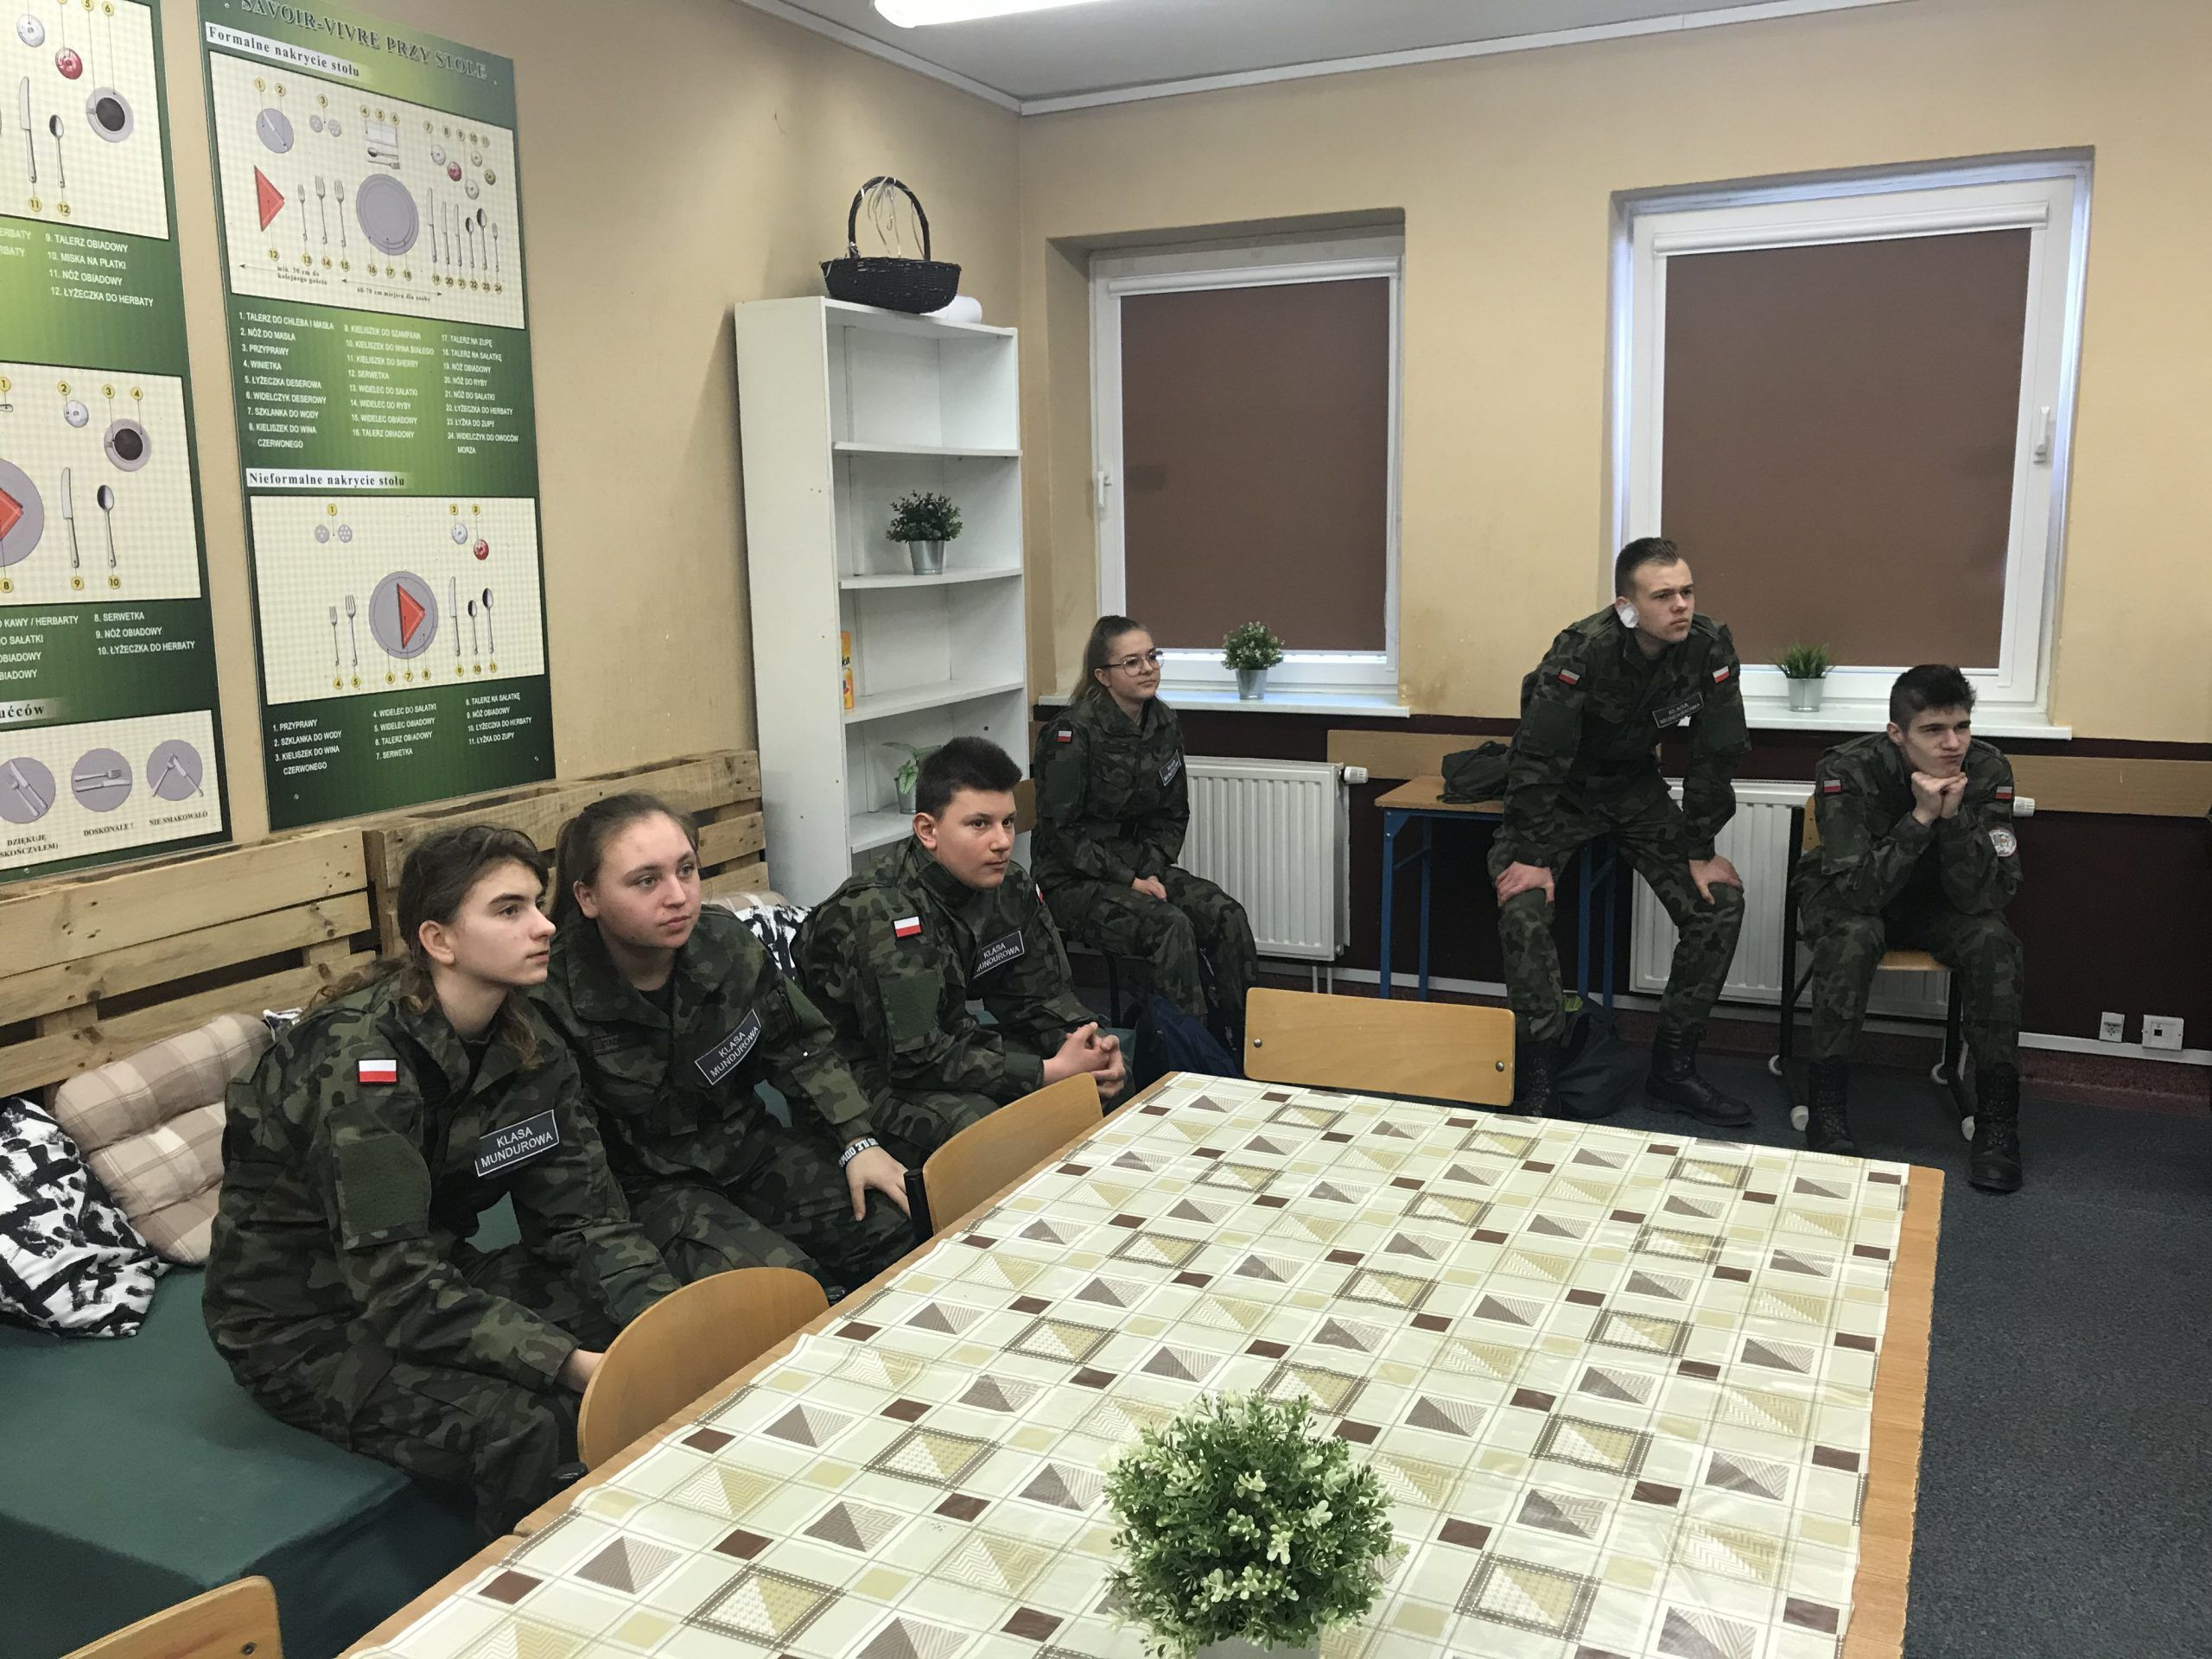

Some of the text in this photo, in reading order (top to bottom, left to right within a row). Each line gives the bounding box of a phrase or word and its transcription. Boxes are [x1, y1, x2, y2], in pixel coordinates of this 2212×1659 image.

[209, 26, 359, 77] Formalne nakrycie stołu
[387, 36, 430, 64] PRZY
[30, 200, 41, 209] 11
[59, 205, 69, 213] 12
[54, 234, 85, 246] TALERZ
[87, 240, 128, 253] OBIADOWY
[48, 251, 127, 270] 10. MISKA NA PŁATKI
[49, 269, 122, 286] 11. NÓŻ OBIADOWY
[51, 287, 154, 307] 12. ŁYŻECZKA DO HERBATY
[246, 312, 271, 323] TALERZ
[283, 317, 308, 327] CHLEBA
[248, 327, 262, 338] NÓŻ
[264, 330, 272, 339] DO
[249, 345, 289, 355] PRZYPRAWY
[251, 360, 282, 370] WINIETKA
[253, 391, 290, 402] WIDELCZYK
[255, 407, 288, 417] SZKLANKA
[300, 410, 319, 419] WODY
[257, 423, 289, 433] KIELISZEK
[300, 425, 317, 434] WINA
[257, 439, 303, 448] CZERWONEGO
[250, 473, 404, 488] Nieformalne nakrycie stołu
[4, 615, 79, 627] KAWY HERBARTY
[104, 612, 145, 621] SERWETKA
[105, 628, 121, 639] NÓŻ
[123, 626, 162, 637] OBIADOWY
[98, 641, 195, 655] 10. ŁYŻECZKA DO HERBATY
[379, 708, 404, 717] WIDELEC
[280, 719, 318, 731] PRZYPRAWY
[380, 721, 405, 731] WIDELEC
[281, 734, 312, 746] SZKLANKA
[324, 730, 342, 740] WODY
[382, 735, 403, 745] TALERZ
[283, 749, 313, 760] KIELISZEK
[324, 746, 340, 754] WINA
[383, 748, 413, 760] SERWETKA
[283, 761, 327, 775] CZERWONEGO
[84, 823, 129, 836] DOSKONALE
[983, 943, 1006, 958] KLASA
[719, 1032, 746, 1058] KLASA
[710, 1027, 759, 1077] MUNDUROWA
[497, 1127, 533, 1147] KLASA
[480, 1132, 554, 1168] MUNDUROWA
